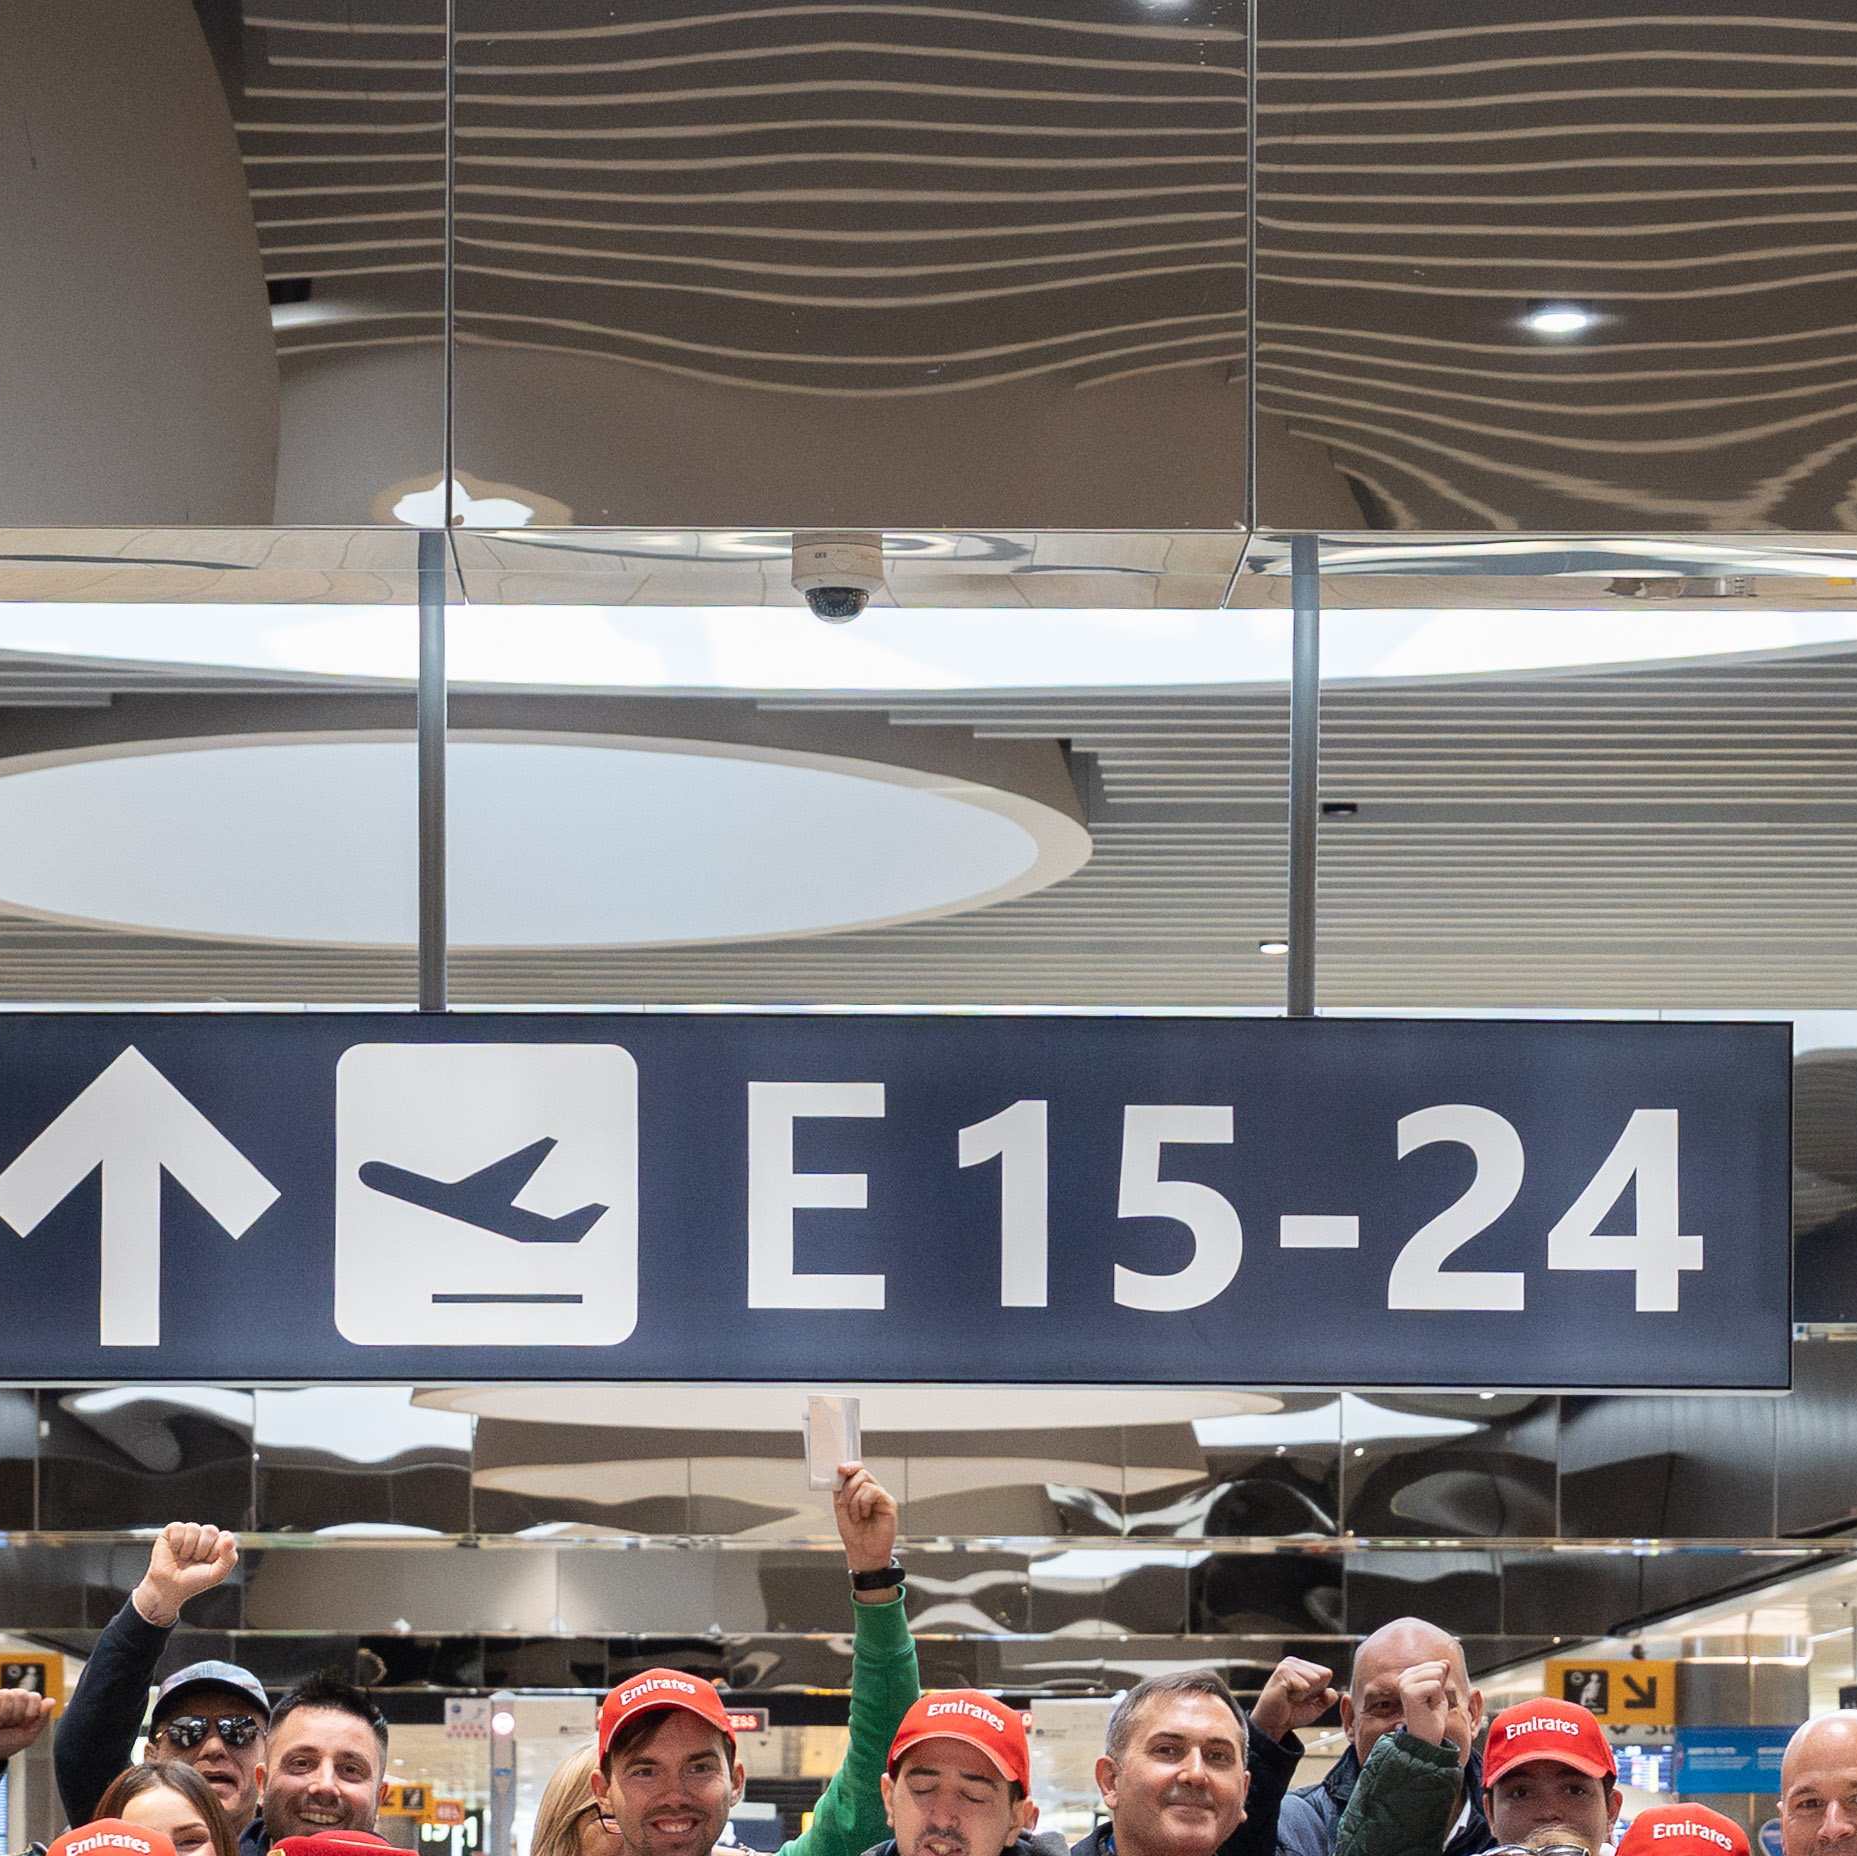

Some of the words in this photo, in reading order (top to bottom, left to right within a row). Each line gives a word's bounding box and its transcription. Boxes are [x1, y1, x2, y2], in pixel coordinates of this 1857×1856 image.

[748, 1082, 885, 1310] E
[959, 1100, 1703, 1312] 15-24
[620, 1677, 696, 1706] Emirates
[926, 1699, 1005, 1732] Emirates
[1505, 1716, 1579, 1741] Emirates
[1653, 1820, 1733, 1851] Emirates
